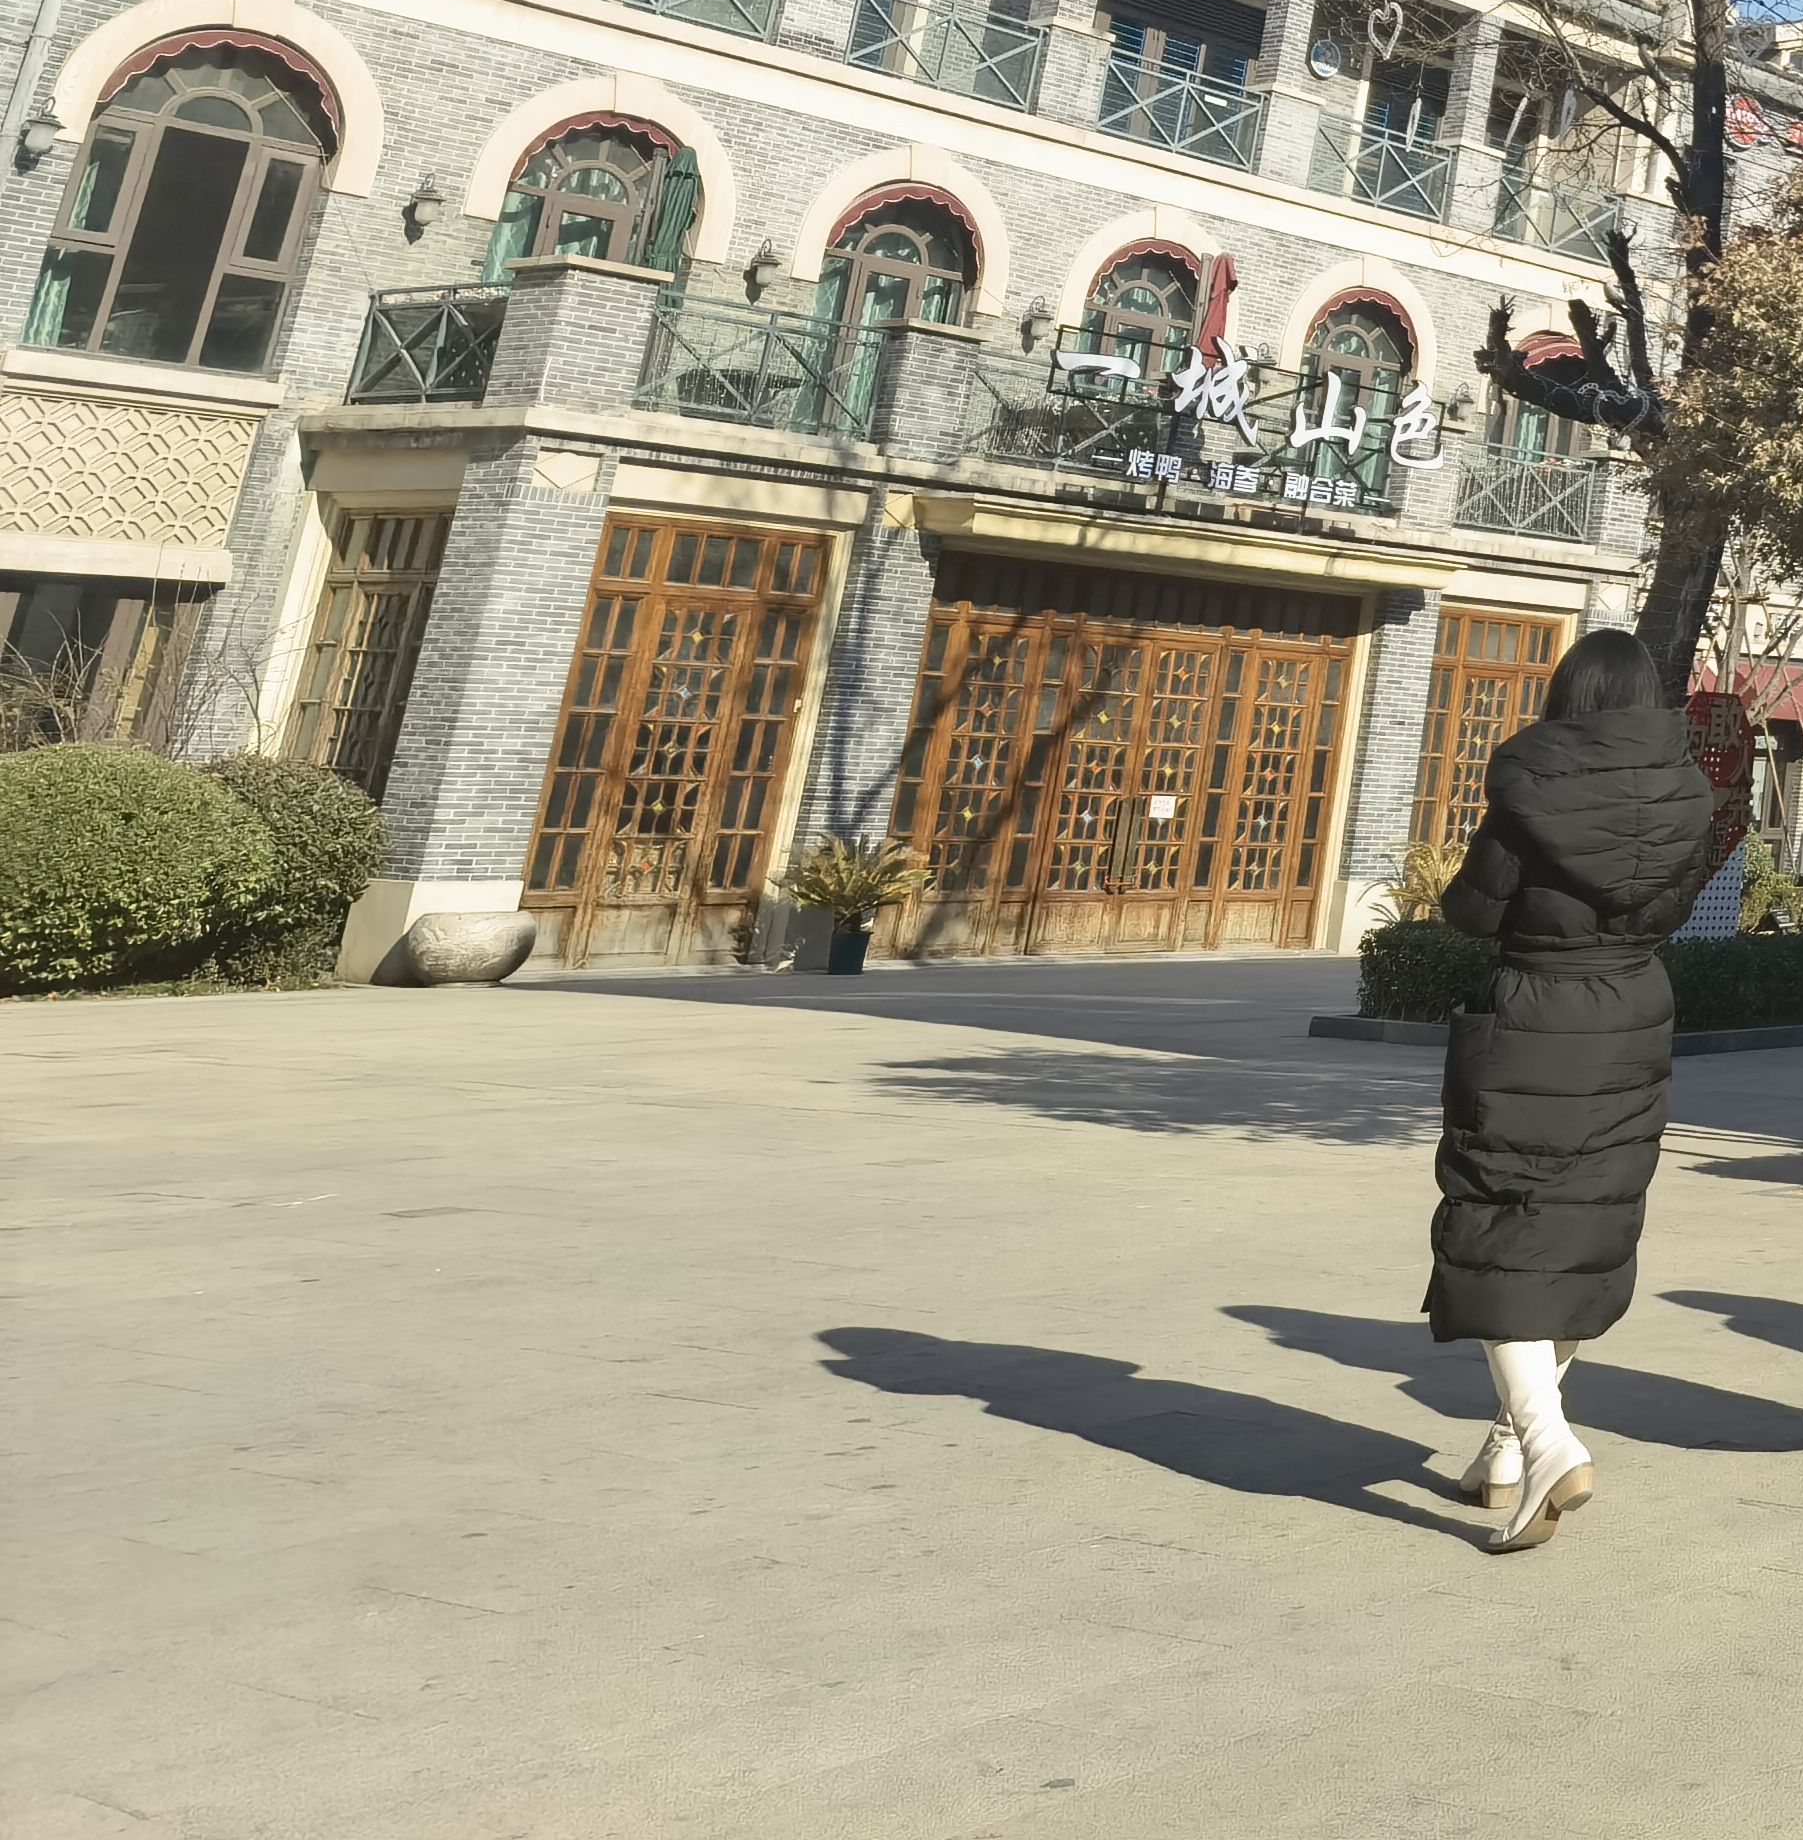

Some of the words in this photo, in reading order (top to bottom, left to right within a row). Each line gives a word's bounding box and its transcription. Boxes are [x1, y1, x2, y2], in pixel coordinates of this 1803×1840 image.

[1126, 448, 1183, 484] 烤鸭
[1207, 462, 1260, 494] 海参
[1284, 472, 1357, 507] 融合菜
